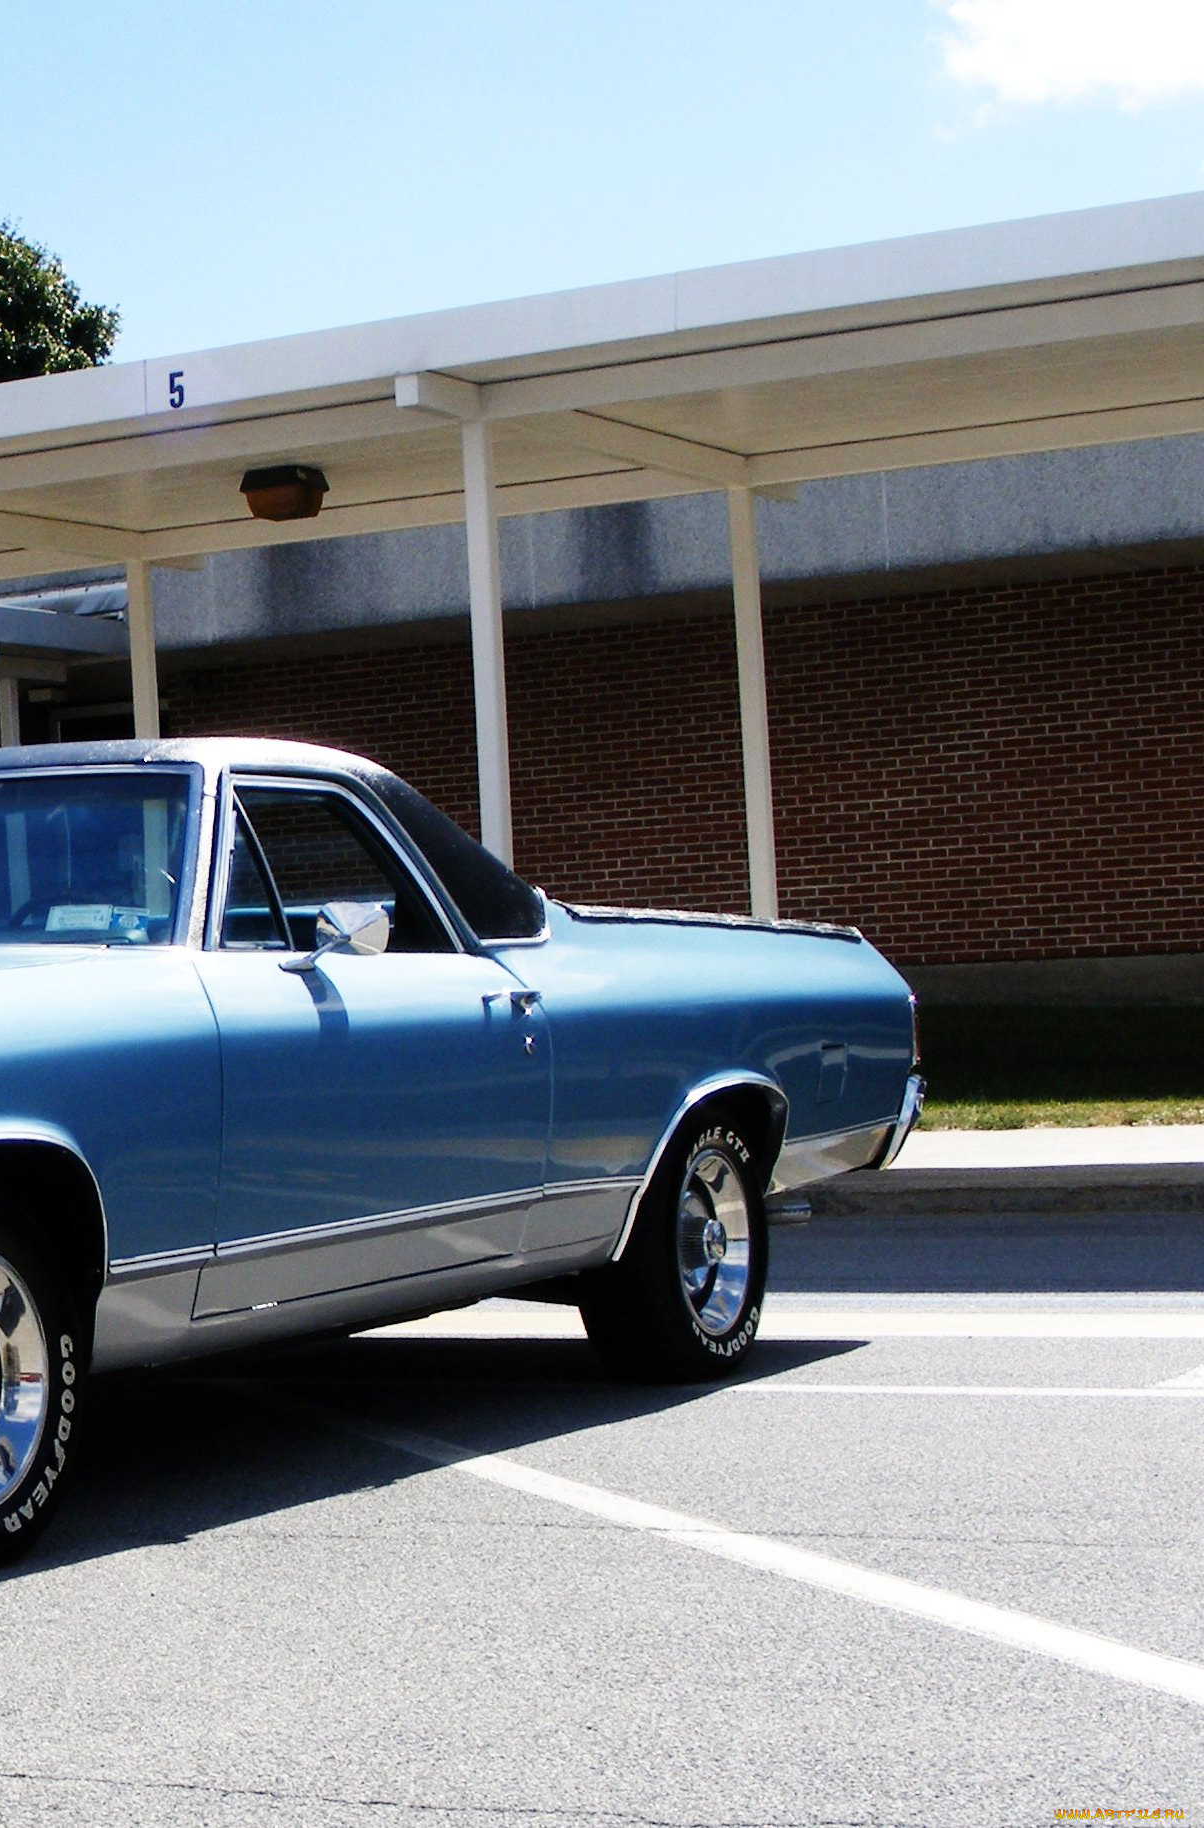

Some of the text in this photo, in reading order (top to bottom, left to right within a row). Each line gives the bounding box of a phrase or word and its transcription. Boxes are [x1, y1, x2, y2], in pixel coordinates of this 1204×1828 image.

[169, 371, 184, 408] 5
[692, 1306, 759, 1357] GOODYEAR
[3, 1334, 76, 1533] GOODYEAR
